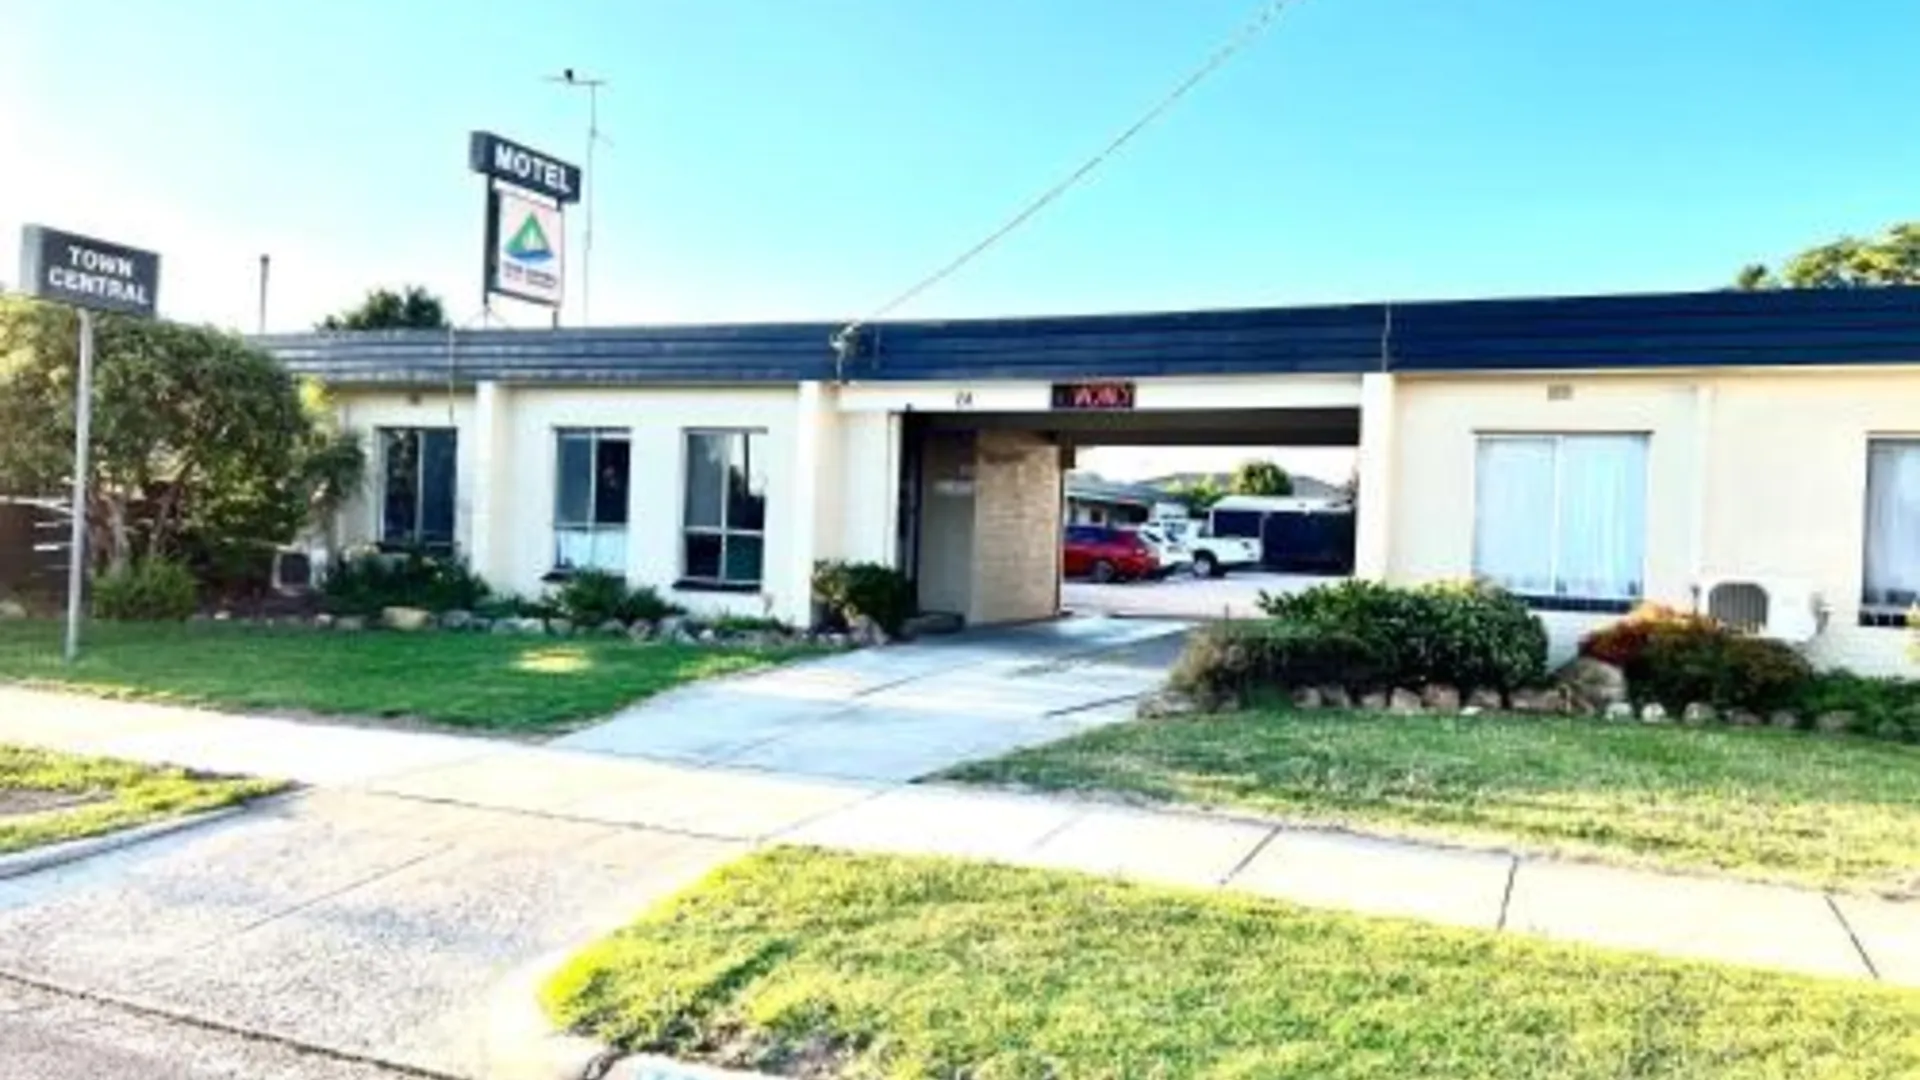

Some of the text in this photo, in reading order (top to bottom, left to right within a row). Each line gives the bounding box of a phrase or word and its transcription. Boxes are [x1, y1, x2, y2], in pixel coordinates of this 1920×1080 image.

[494, 143, 572, 193] MOTEL
[68, 246, 133, 277] TOWN
[49, 265, 149, 304] CENTRAL
